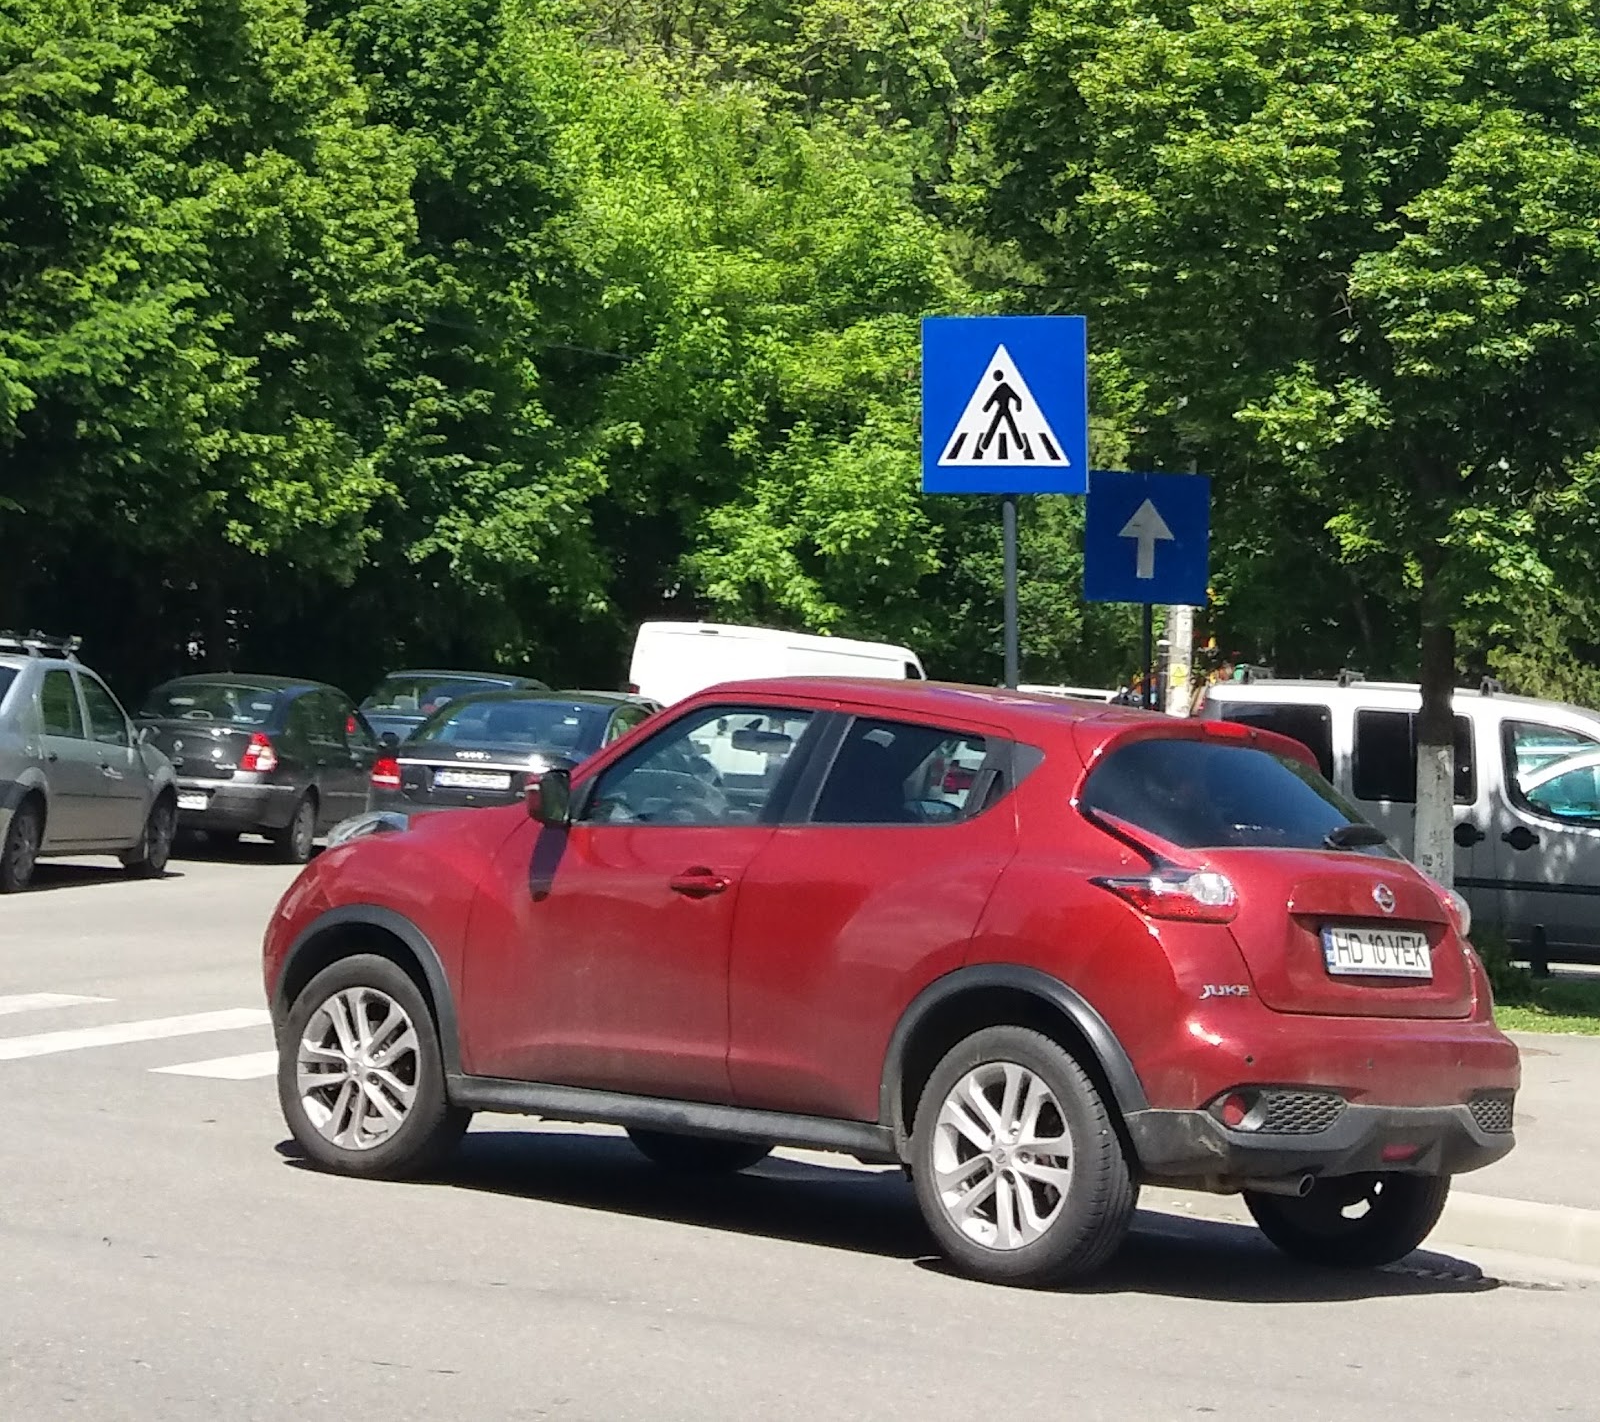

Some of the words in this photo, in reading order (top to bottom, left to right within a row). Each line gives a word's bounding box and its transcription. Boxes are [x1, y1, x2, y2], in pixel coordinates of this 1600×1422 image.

[1335, 933, 1363, 964] HD
[1368, 933, 1386, 965] 10
[1387, 934, 1426, 967] VEK
[1199, 984, 1250, 999] JUKE
